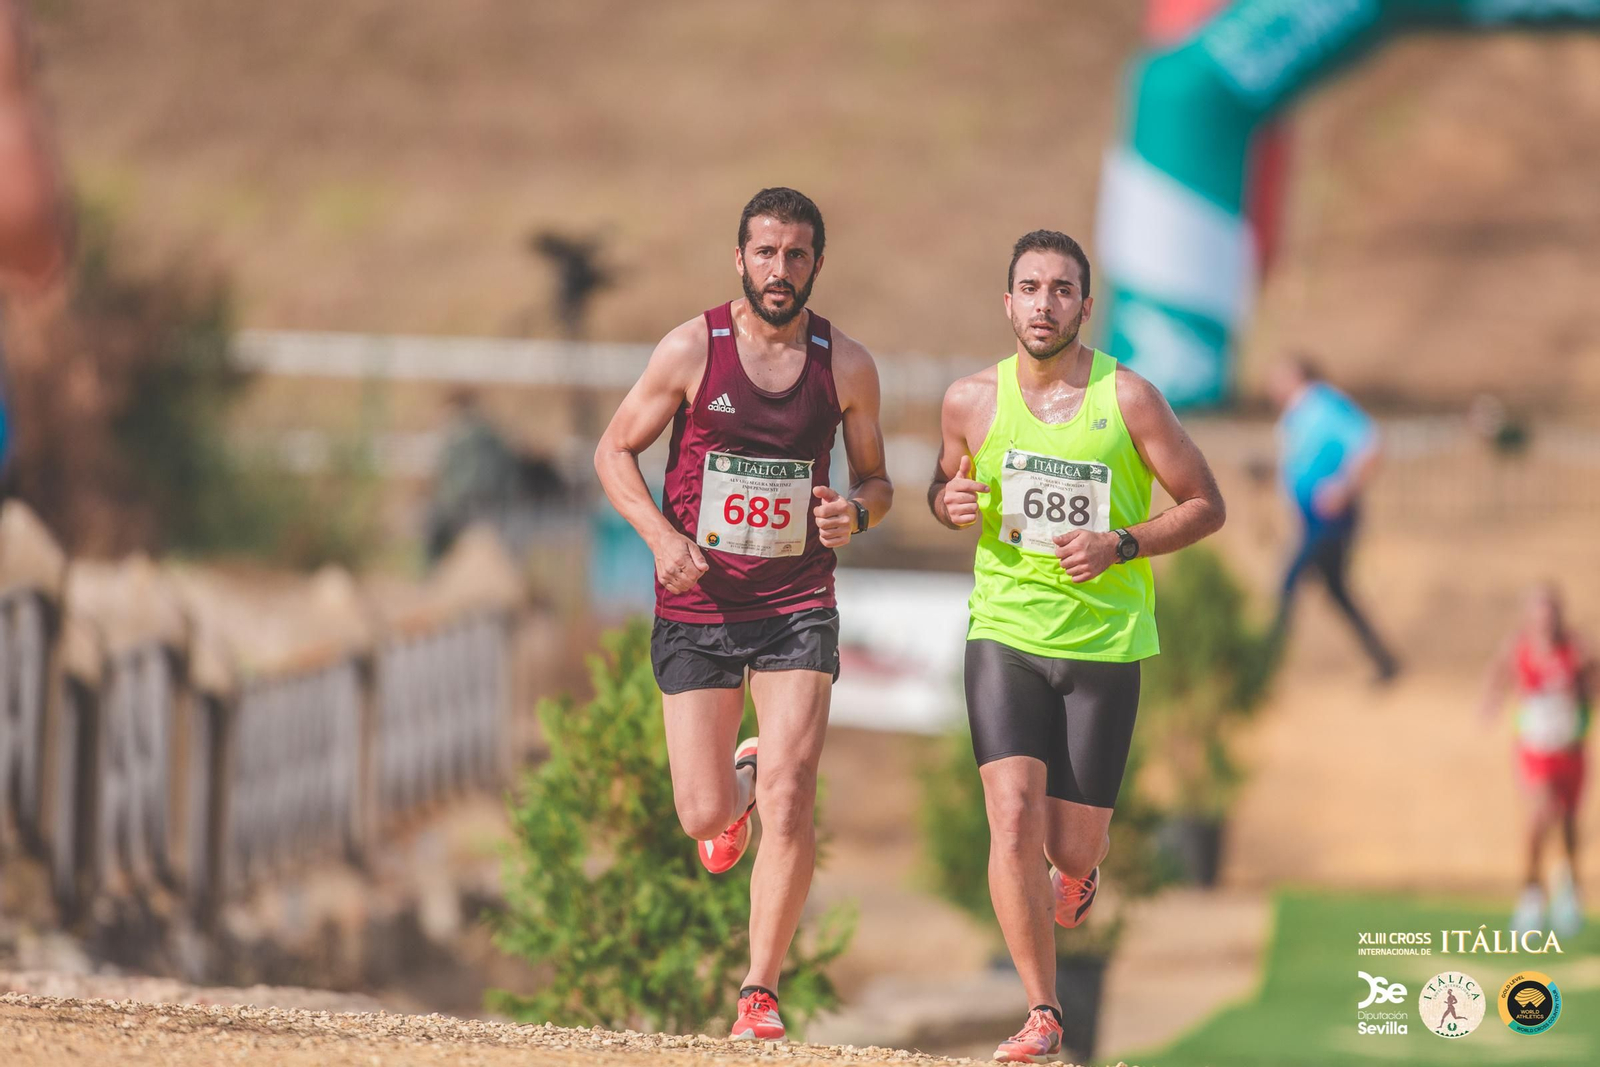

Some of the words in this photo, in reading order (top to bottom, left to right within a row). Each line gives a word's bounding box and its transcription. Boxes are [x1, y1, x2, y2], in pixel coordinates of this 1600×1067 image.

[707, 403, 735, 414] adidas
[737, 460, 787, 476] ITÁLICA
[1033, 459, 1082, 477] ITÁLICA
[723, 493, 791, 530] 685
[1023, 488, 1090, 526] 688
